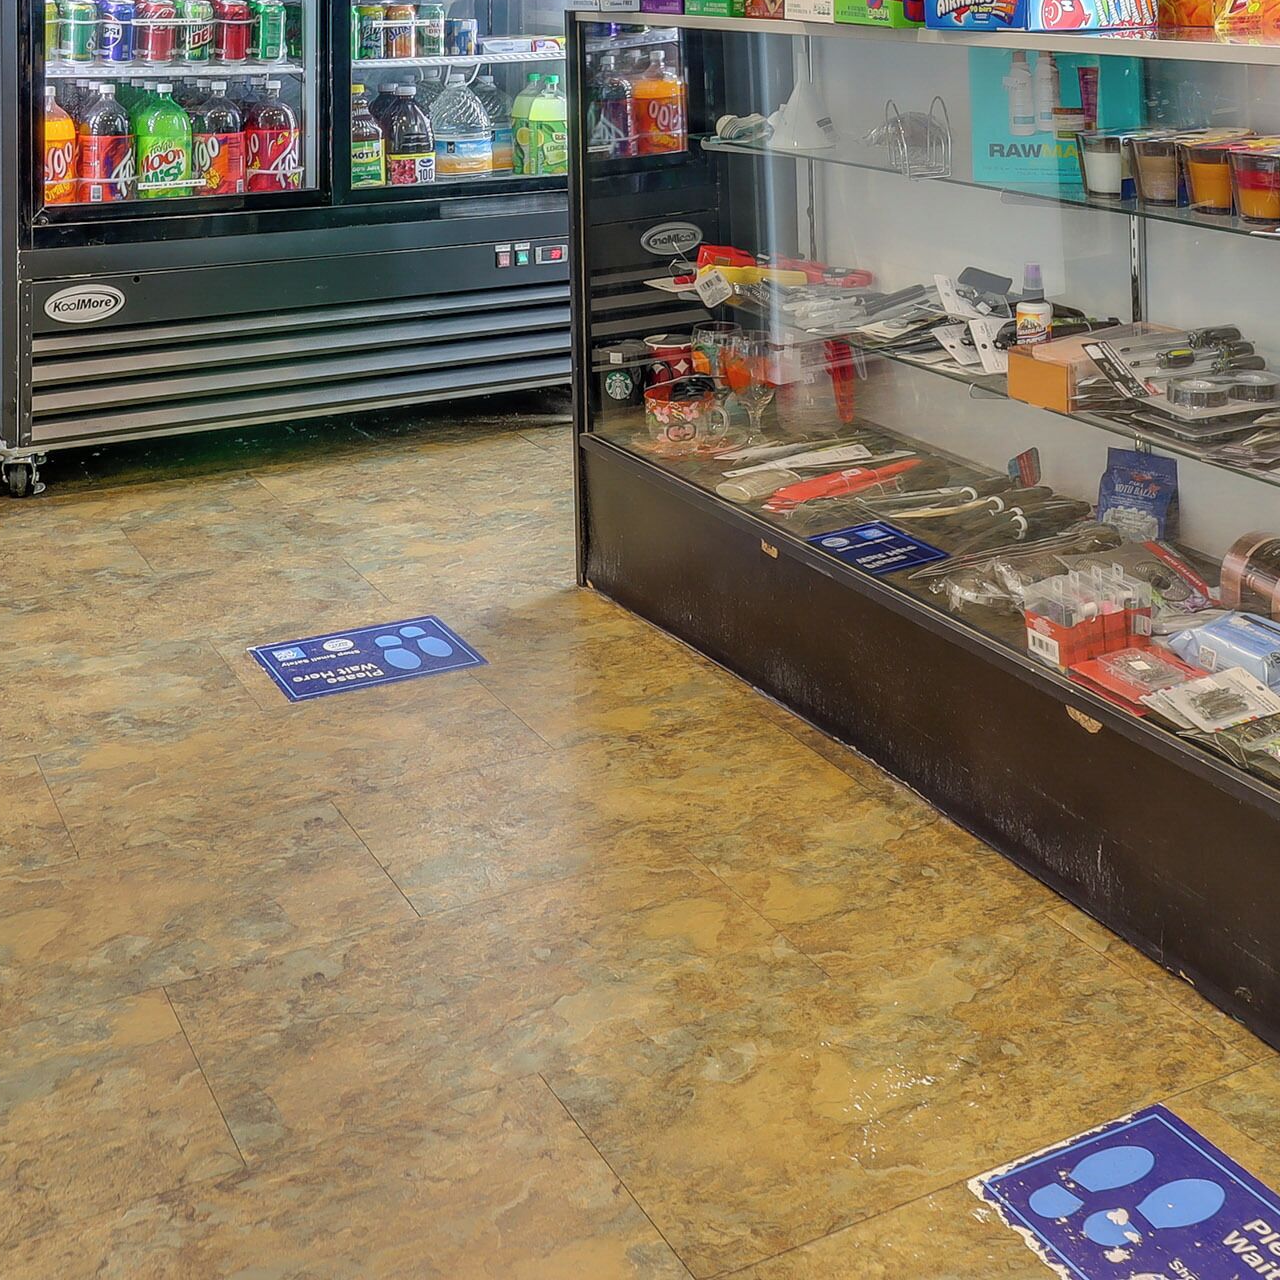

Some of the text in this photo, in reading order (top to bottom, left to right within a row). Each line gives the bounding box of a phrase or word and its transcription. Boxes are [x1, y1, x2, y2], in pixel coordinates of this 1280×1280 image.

[53, 297, 113, 314] KoolMore
[292, 662, 378, 684] Wait Here
[326, 669, 385, 684] Please
